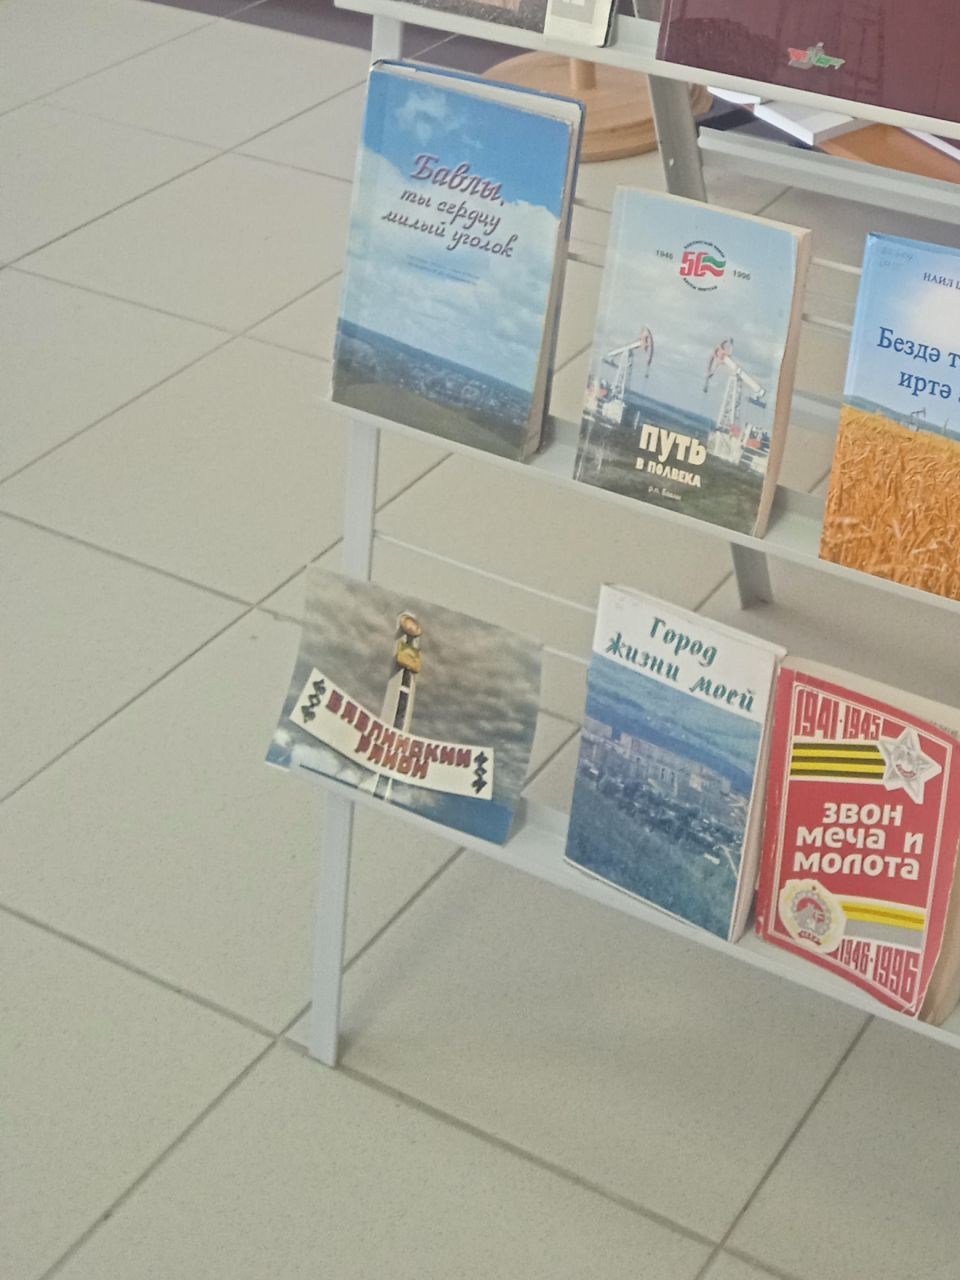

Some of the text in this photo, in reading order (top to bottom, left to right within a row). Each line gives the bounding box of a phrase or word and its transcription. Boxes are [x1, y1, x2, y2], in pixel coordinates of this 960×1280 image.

[410, 154, 505, 207] Бавлы,
[381, 211, 518, 258] милый уголок
[400, 189, 501, 236] ты сердцу
[923, 272, 953, 288] НАИЛ
[877, 326, 941, 363] Бездә
[898, 371, 952, 399] иртә
[639, 423, 706, 465] ПУТЬ
[635, 457, 701, 488] В ПОЛВЕКА
[648, 617, 718, 666] Город
[605, 632, 755, 713] жизни моей
